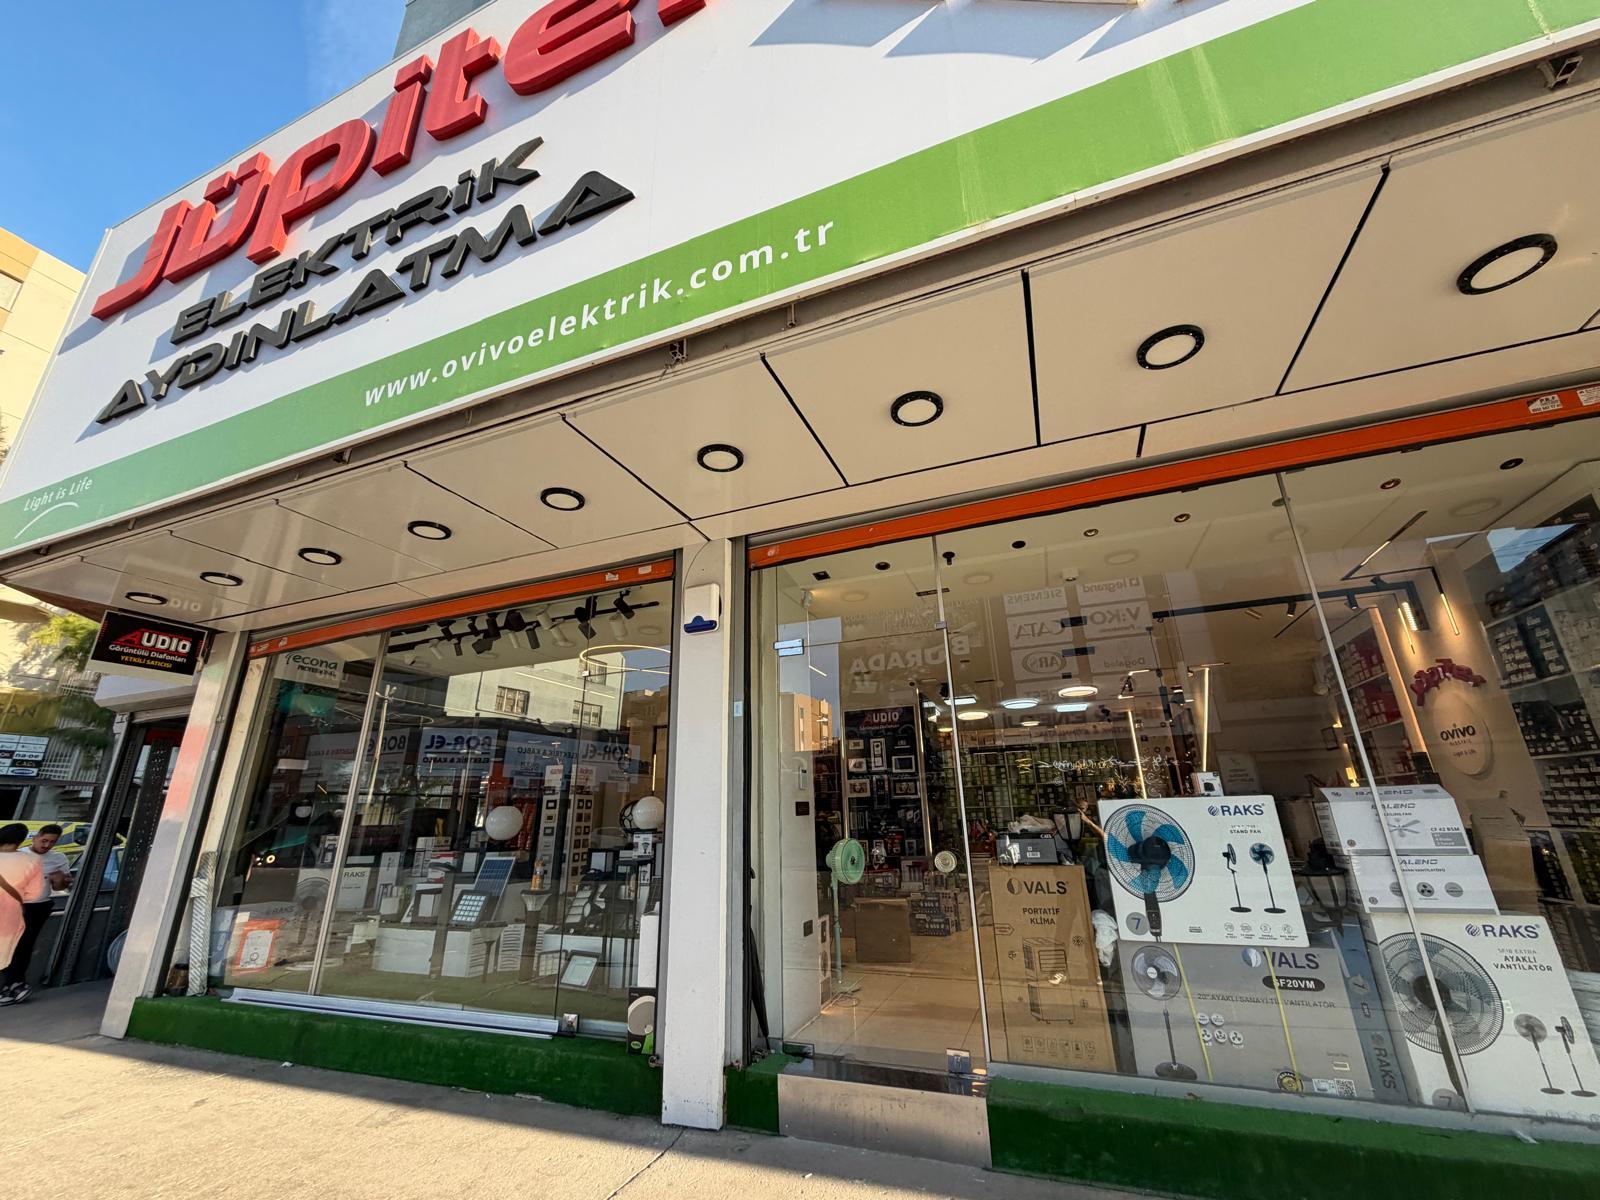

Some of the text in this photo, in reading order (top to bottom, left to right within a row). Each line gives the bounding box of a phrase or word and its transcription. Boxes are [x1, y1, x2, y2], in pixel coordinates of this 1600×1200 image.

[96, 170, 635, 425] AYDINLATMA
[365, 220, 834, 407] www.ovivoelektrik.com.tr
[24, 476, 93, 511] Light is Life
[113, 629, 192, 654] AUDIO
[109, 644, 187, 663] Görüntülü Diafonları
[121, 655, 172, 668] YETKİLİ SATICISI
[861, 711, 900, 723] AUDIO
[1220, 804, 1264, 816] RAKS
[1399, 858, 1438, 866] ALENO
[1023, 880, 1068, 895] VALS
[1022, 907, 1061, 915] PORTATİF
[1029, 916, 1056, 925] KLİMA
[1482, 924, 1540, 939] RAKS
[1503, 955, 1537, 964] AYAKLI
[1493, 962, 1553, 972] VANTİLATÖR
[1374, 1047, 1398, 1090] RAKS
